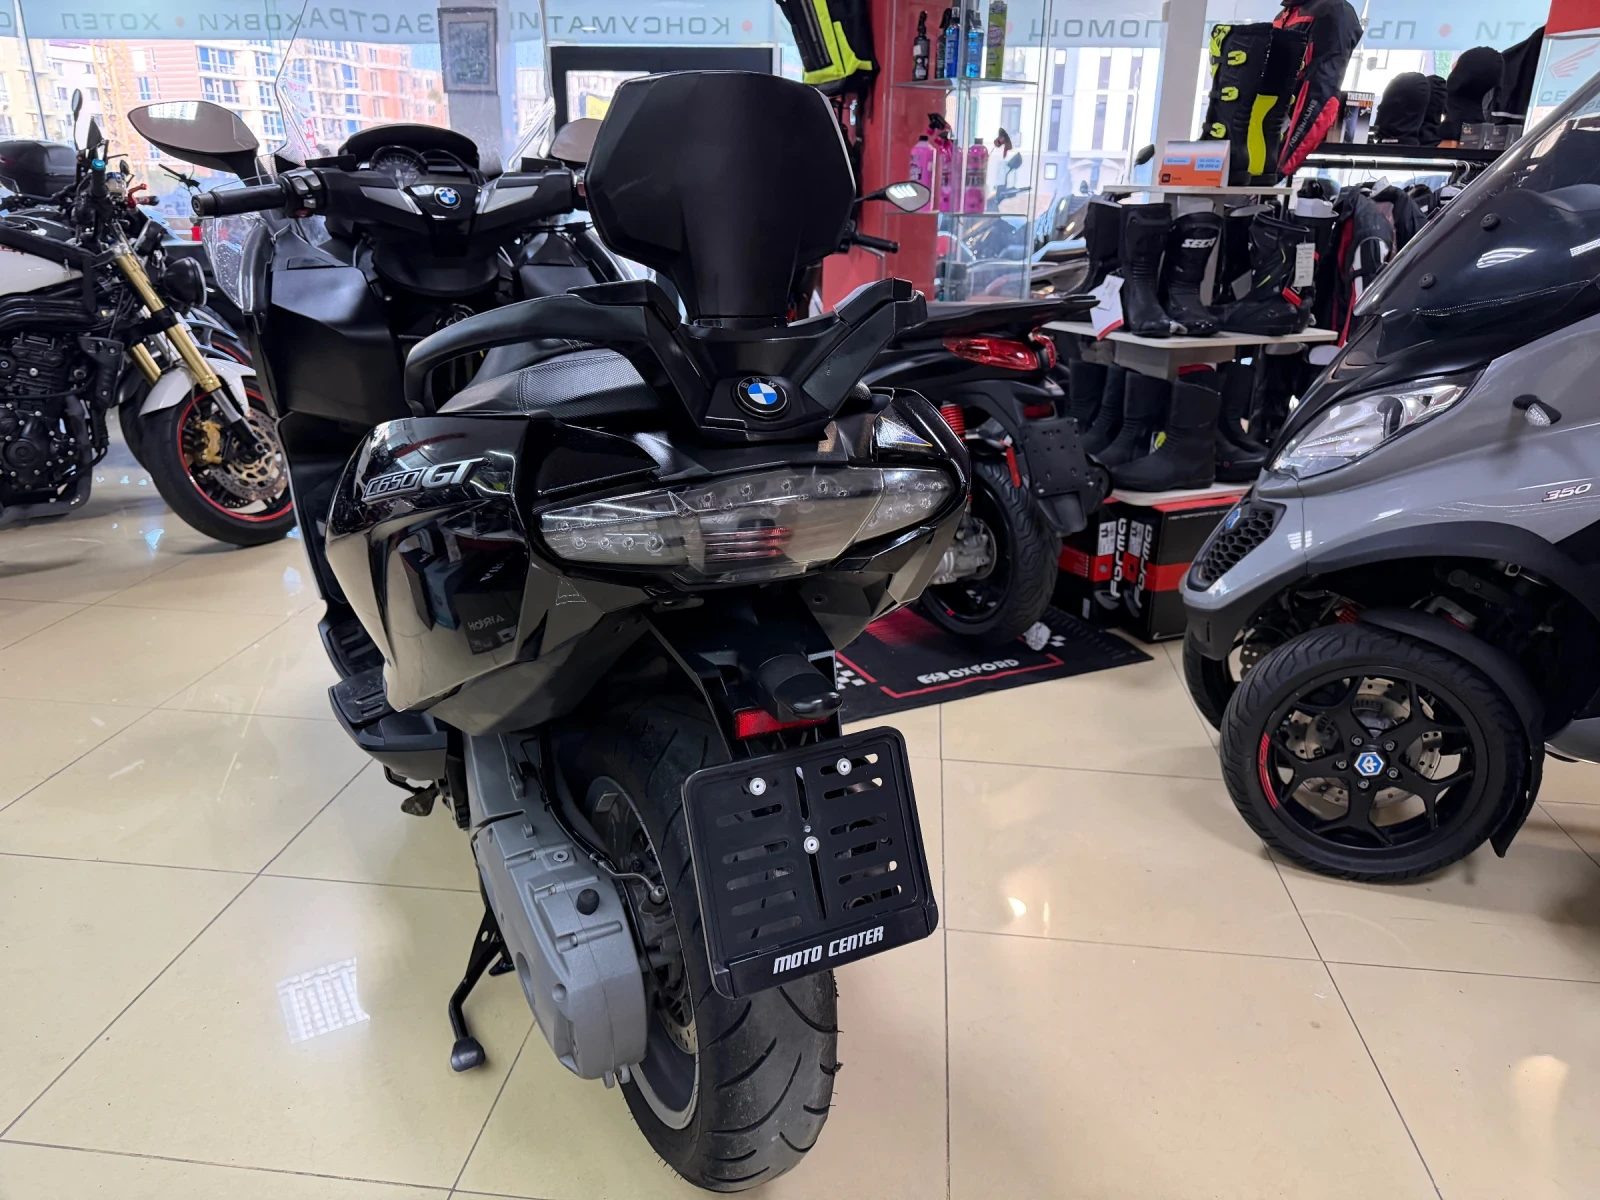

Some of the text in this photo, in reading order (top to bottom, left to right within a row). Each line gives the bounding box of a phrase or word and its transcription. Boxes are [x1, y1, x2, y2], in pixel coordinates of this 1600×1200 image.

[740, 376, 777, 389] BMW
[365, 457, 485, 496] C650 GT
[1543, 483, 1592, 501] 350
[948, 658, 1020, 678] OXFORD
[772, 925, 884, 975] MOTO CENTER
